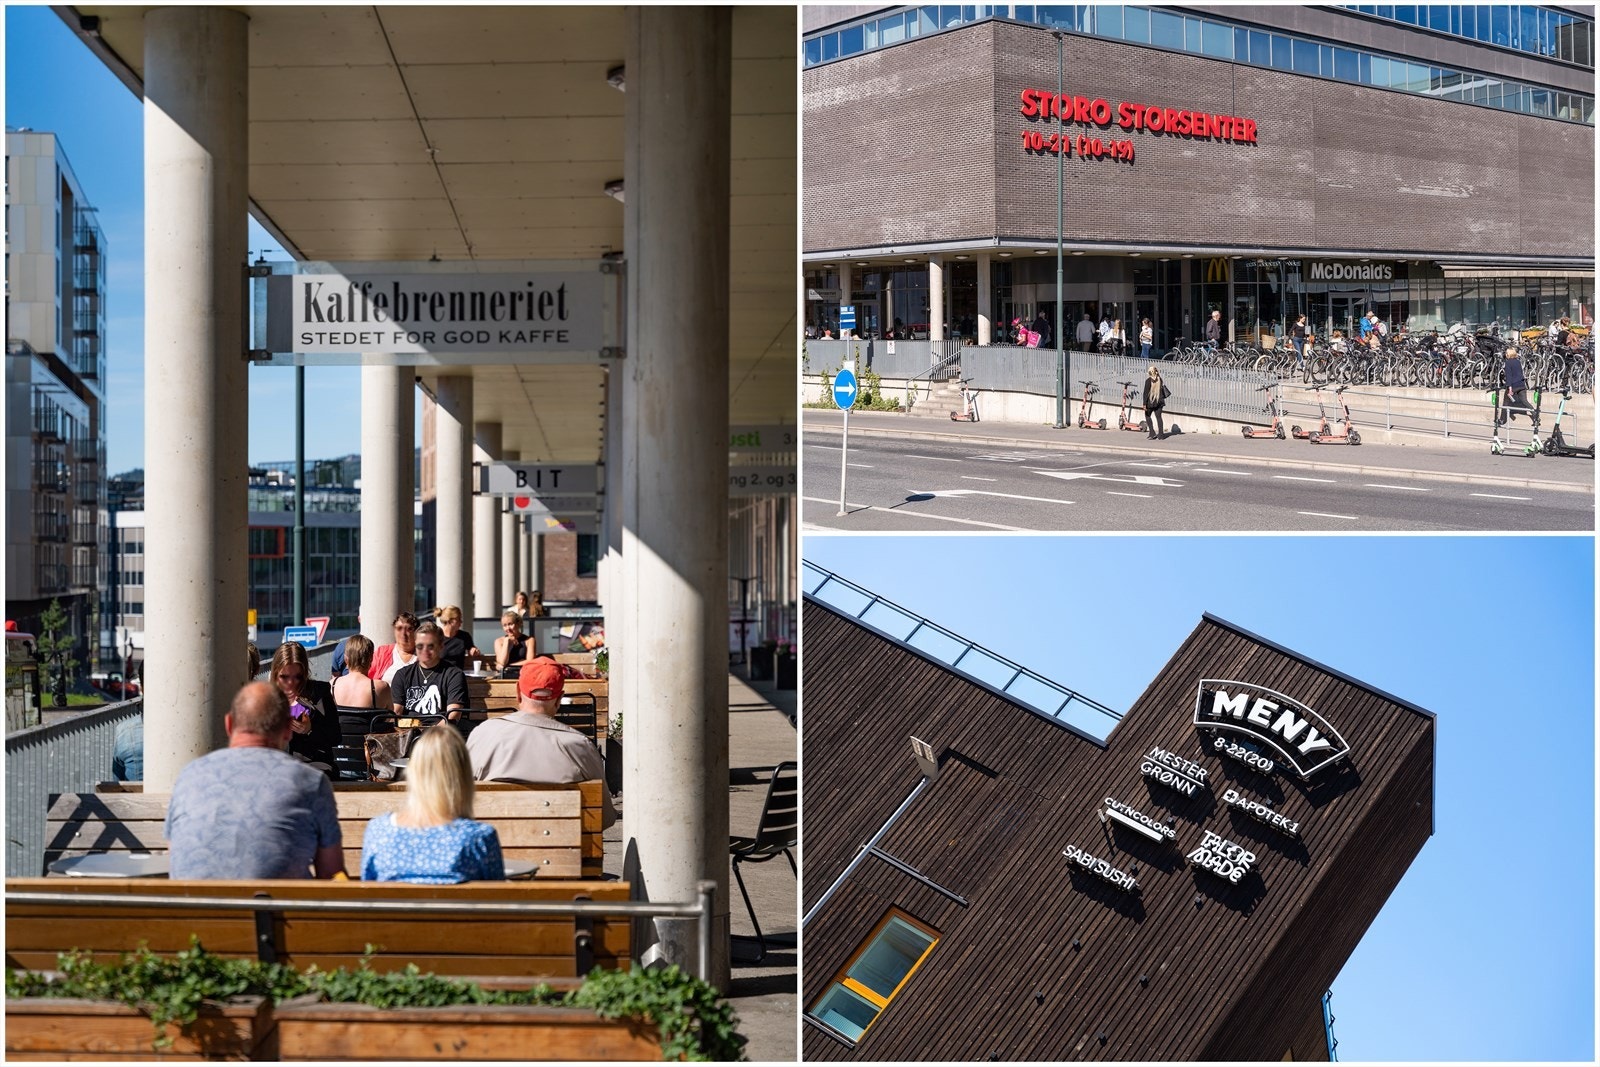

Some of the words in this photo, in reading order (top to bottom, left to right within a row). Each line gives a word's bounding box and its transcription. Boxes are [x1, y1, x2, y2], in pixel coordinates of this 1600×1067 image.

[1021, 88, 1112, 125] STORO
[1118, 102, 1257, 142] STORSENTER
[1021, 131, 1071, 153] 10-21
[1076, 134, 1134, 161] (10-19)
[1311, 262, 1393, 280] McDonald's
[303, 281, 570, 323] Kaffebrenneriet
[301, 331, 385, 345] STEDET
[393, 330, 436, 345] FOR
[444, 330, 490, 344] GOD
[499, 329, 570, 343] KAFFE
[516, 469, 562, 489] BIT
[766, 475, 784, 488] og
[1212, 691, 1331, 757] MENY
[1149, 746, 1208, 780] MESTER
[1214, 737, 1275, 772] 8-22(20)
[1140, 761, 1196, 796] GRØNN
[1236, 797, 1292, 830] APOTEK
